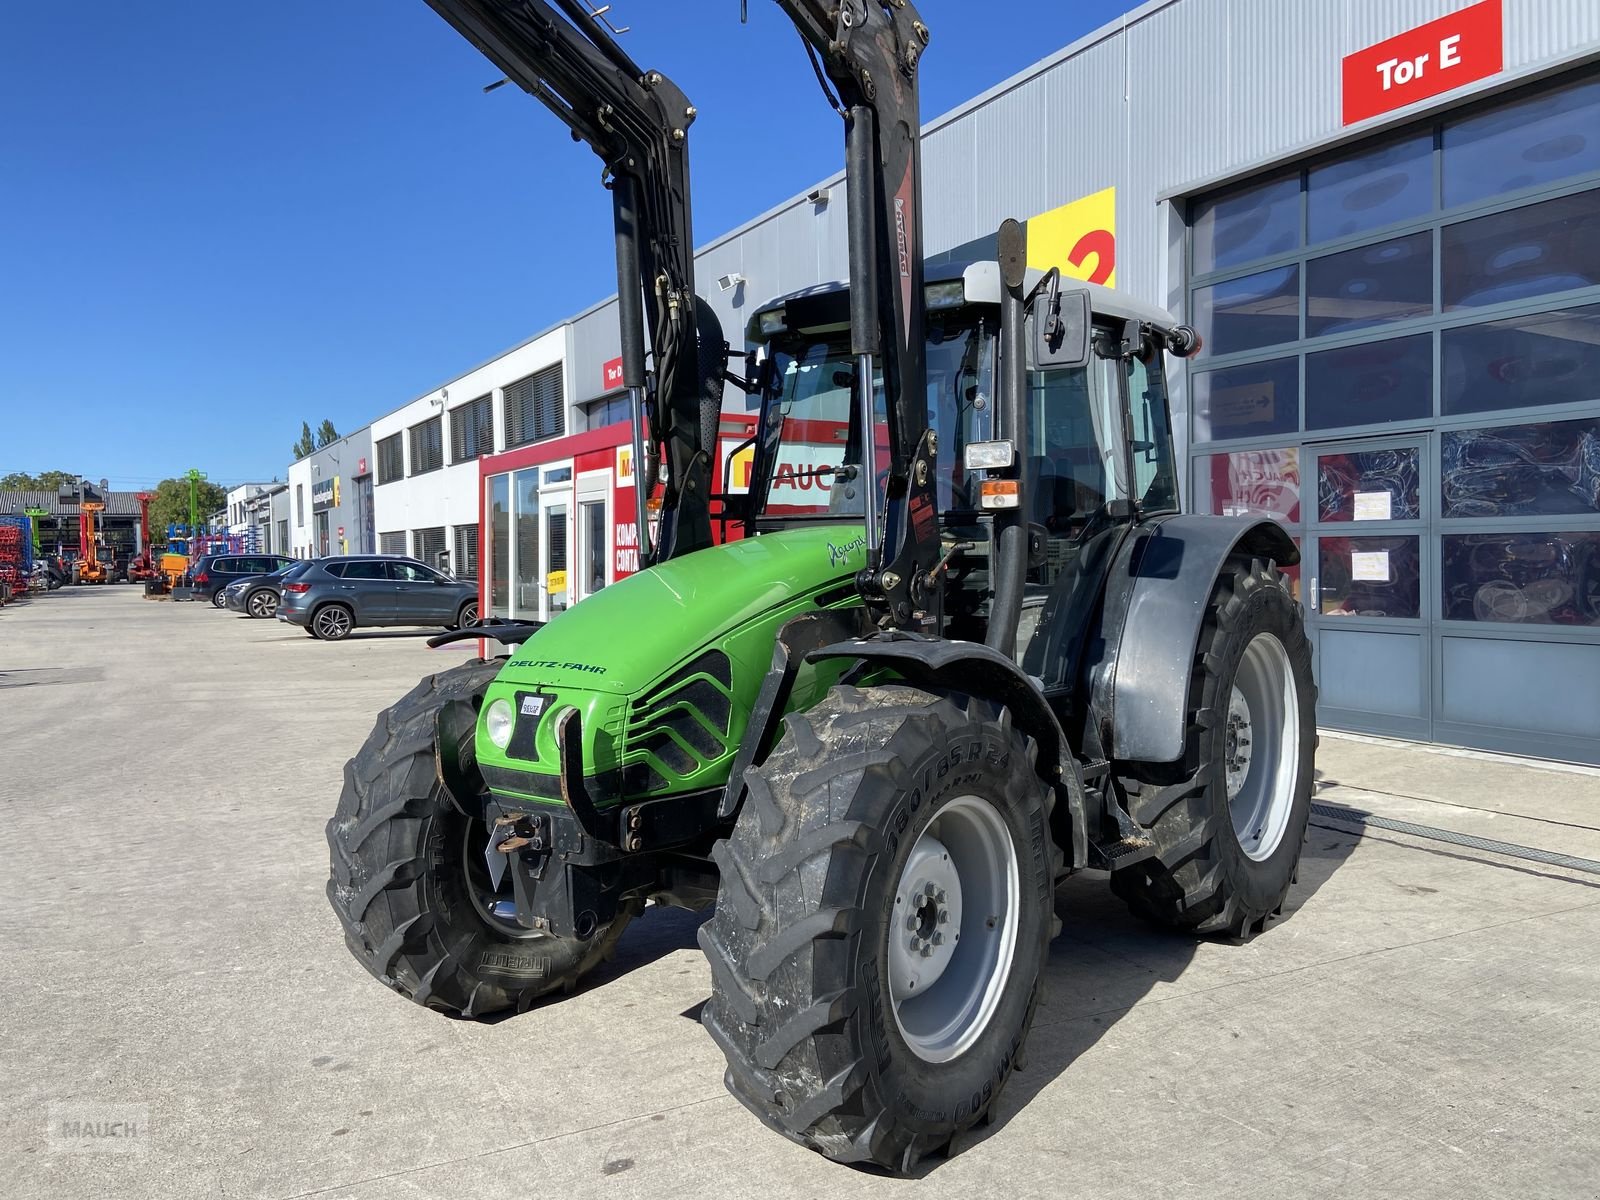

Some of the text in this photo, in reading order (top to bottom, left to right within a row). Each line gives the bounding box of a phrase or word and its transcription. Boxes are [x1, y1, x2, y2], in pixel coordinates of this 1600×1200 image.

[1376, 33, 1461, 91] Tor E
[607, 368, 617, 381] Tor
